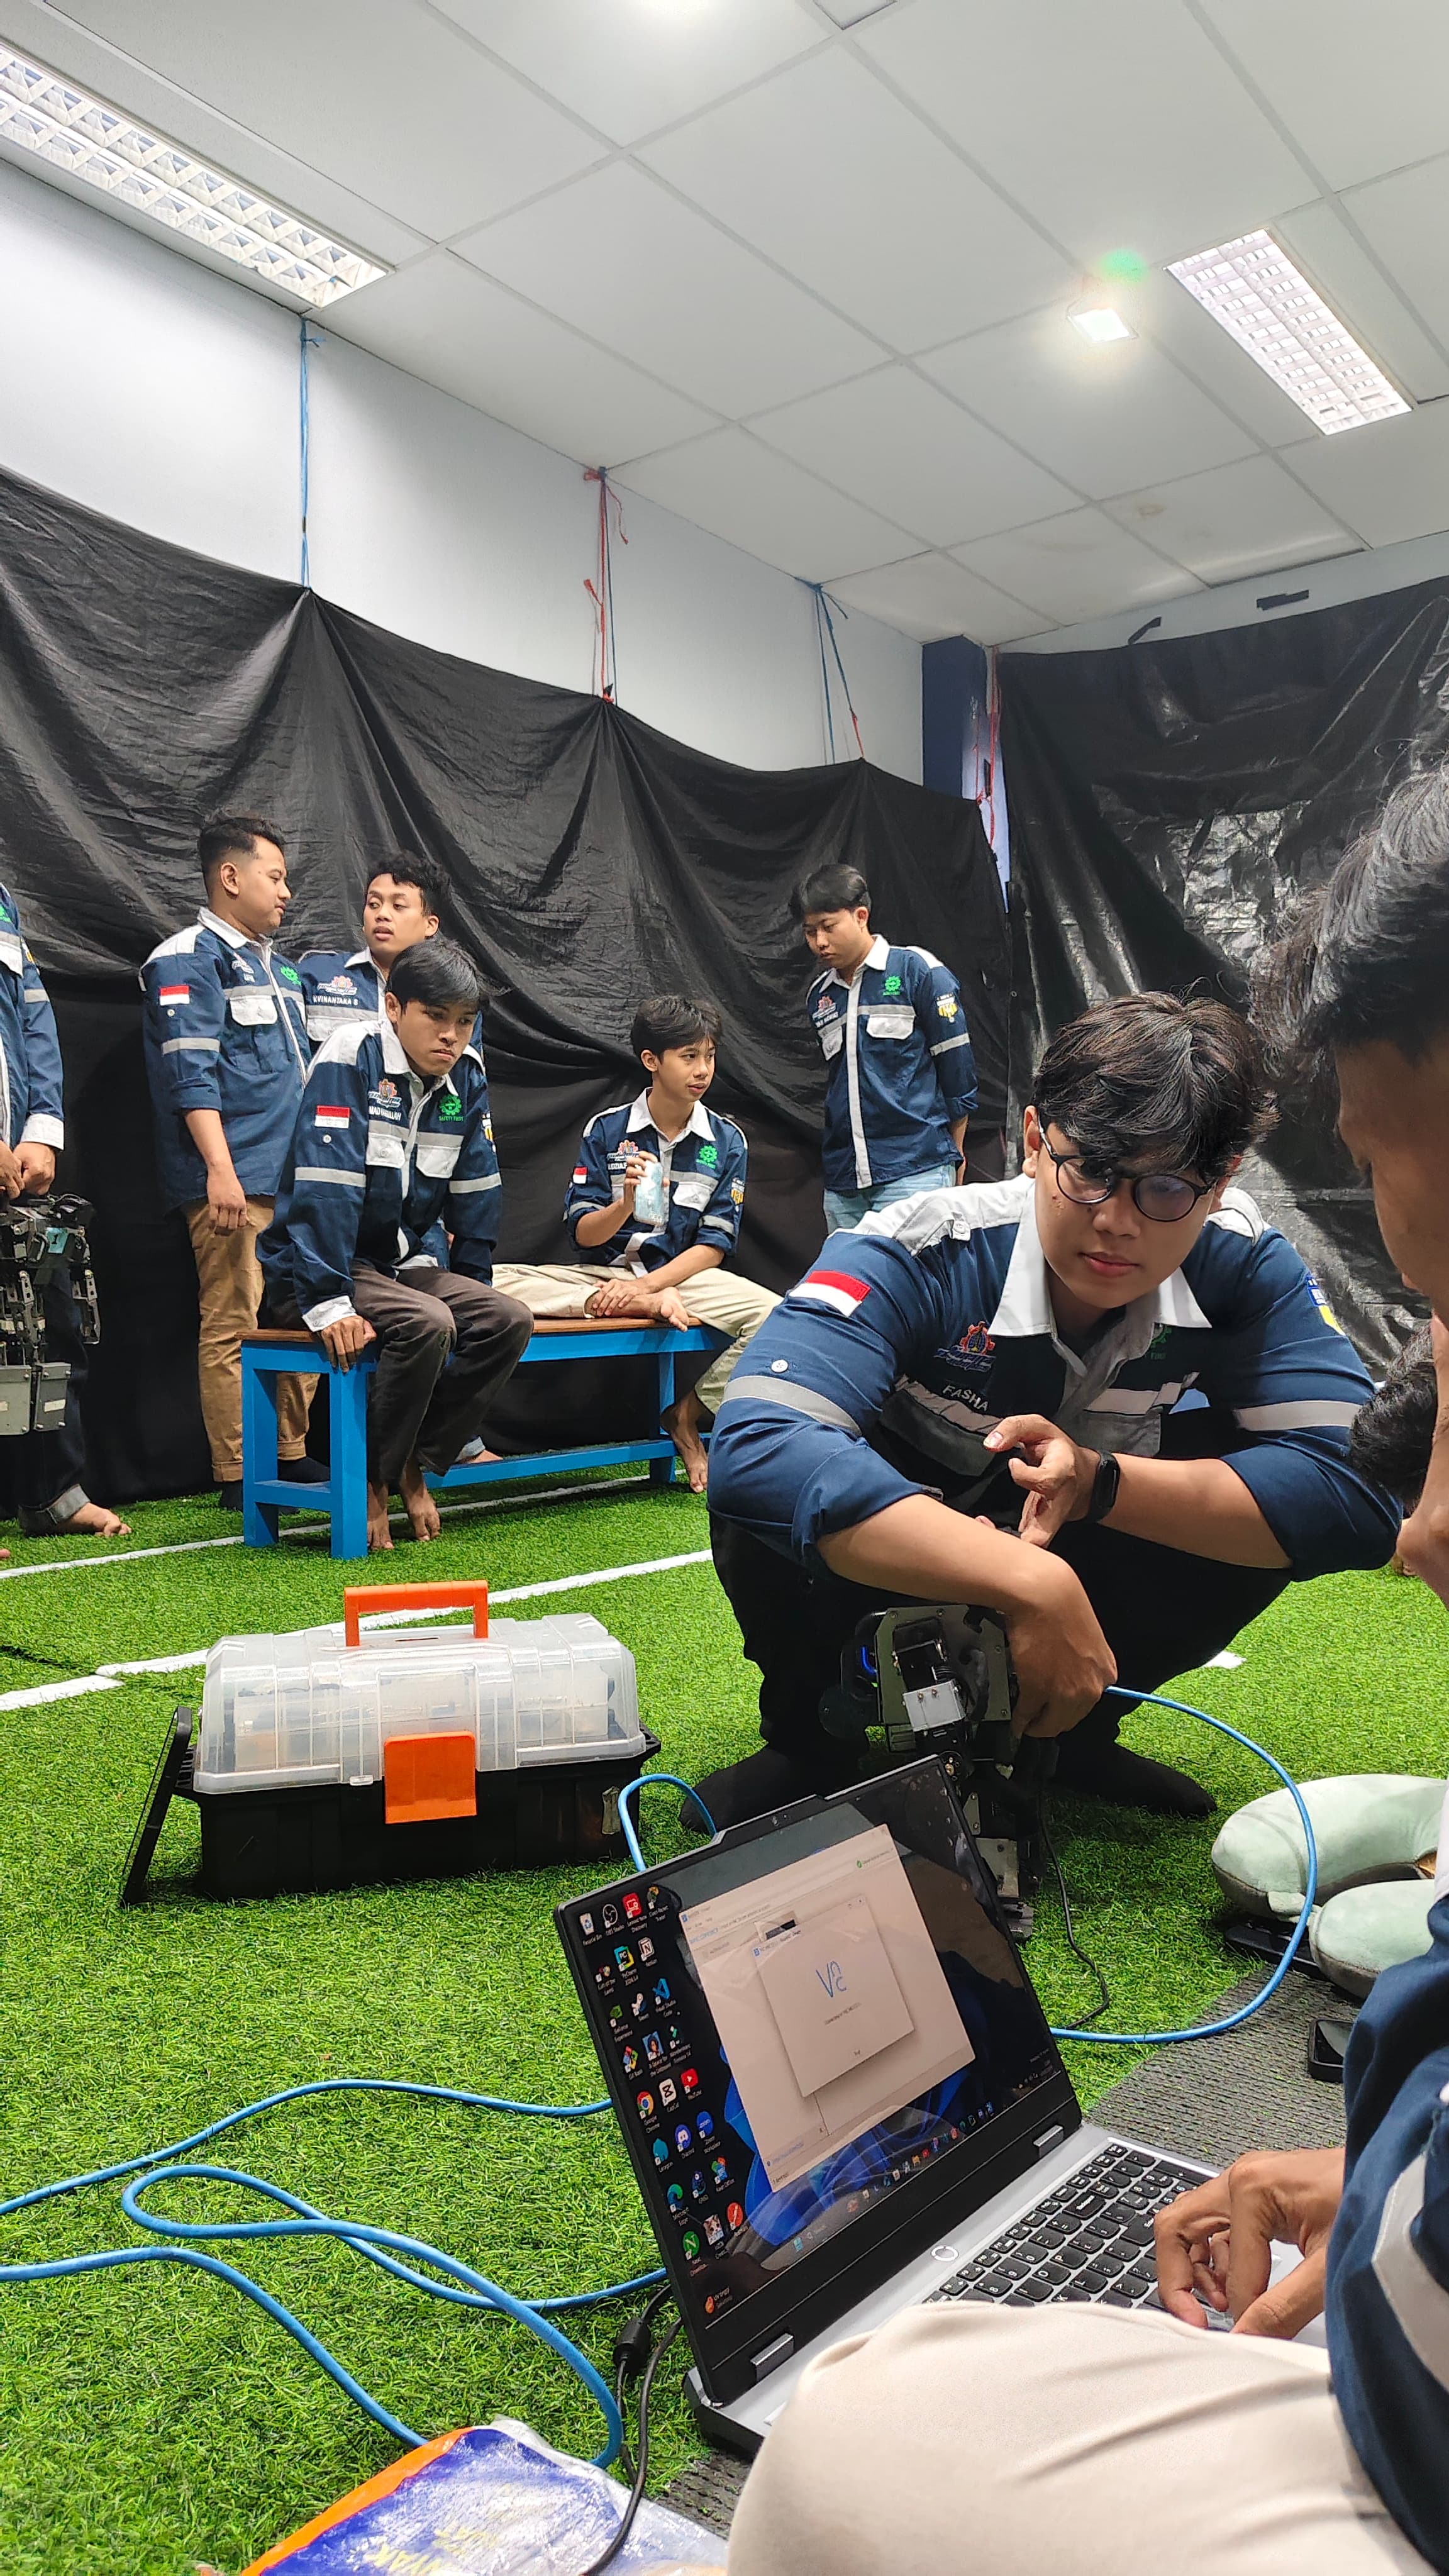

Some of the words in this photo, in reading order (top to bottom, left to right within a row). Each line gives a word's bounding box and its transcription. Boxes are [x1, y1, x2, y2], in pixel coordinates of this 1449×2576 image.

[51, 1233, 58, 1245] 1
[943, 1385, 989, 1412] FASHA
[1055, 2254, 1064, 2262] P
